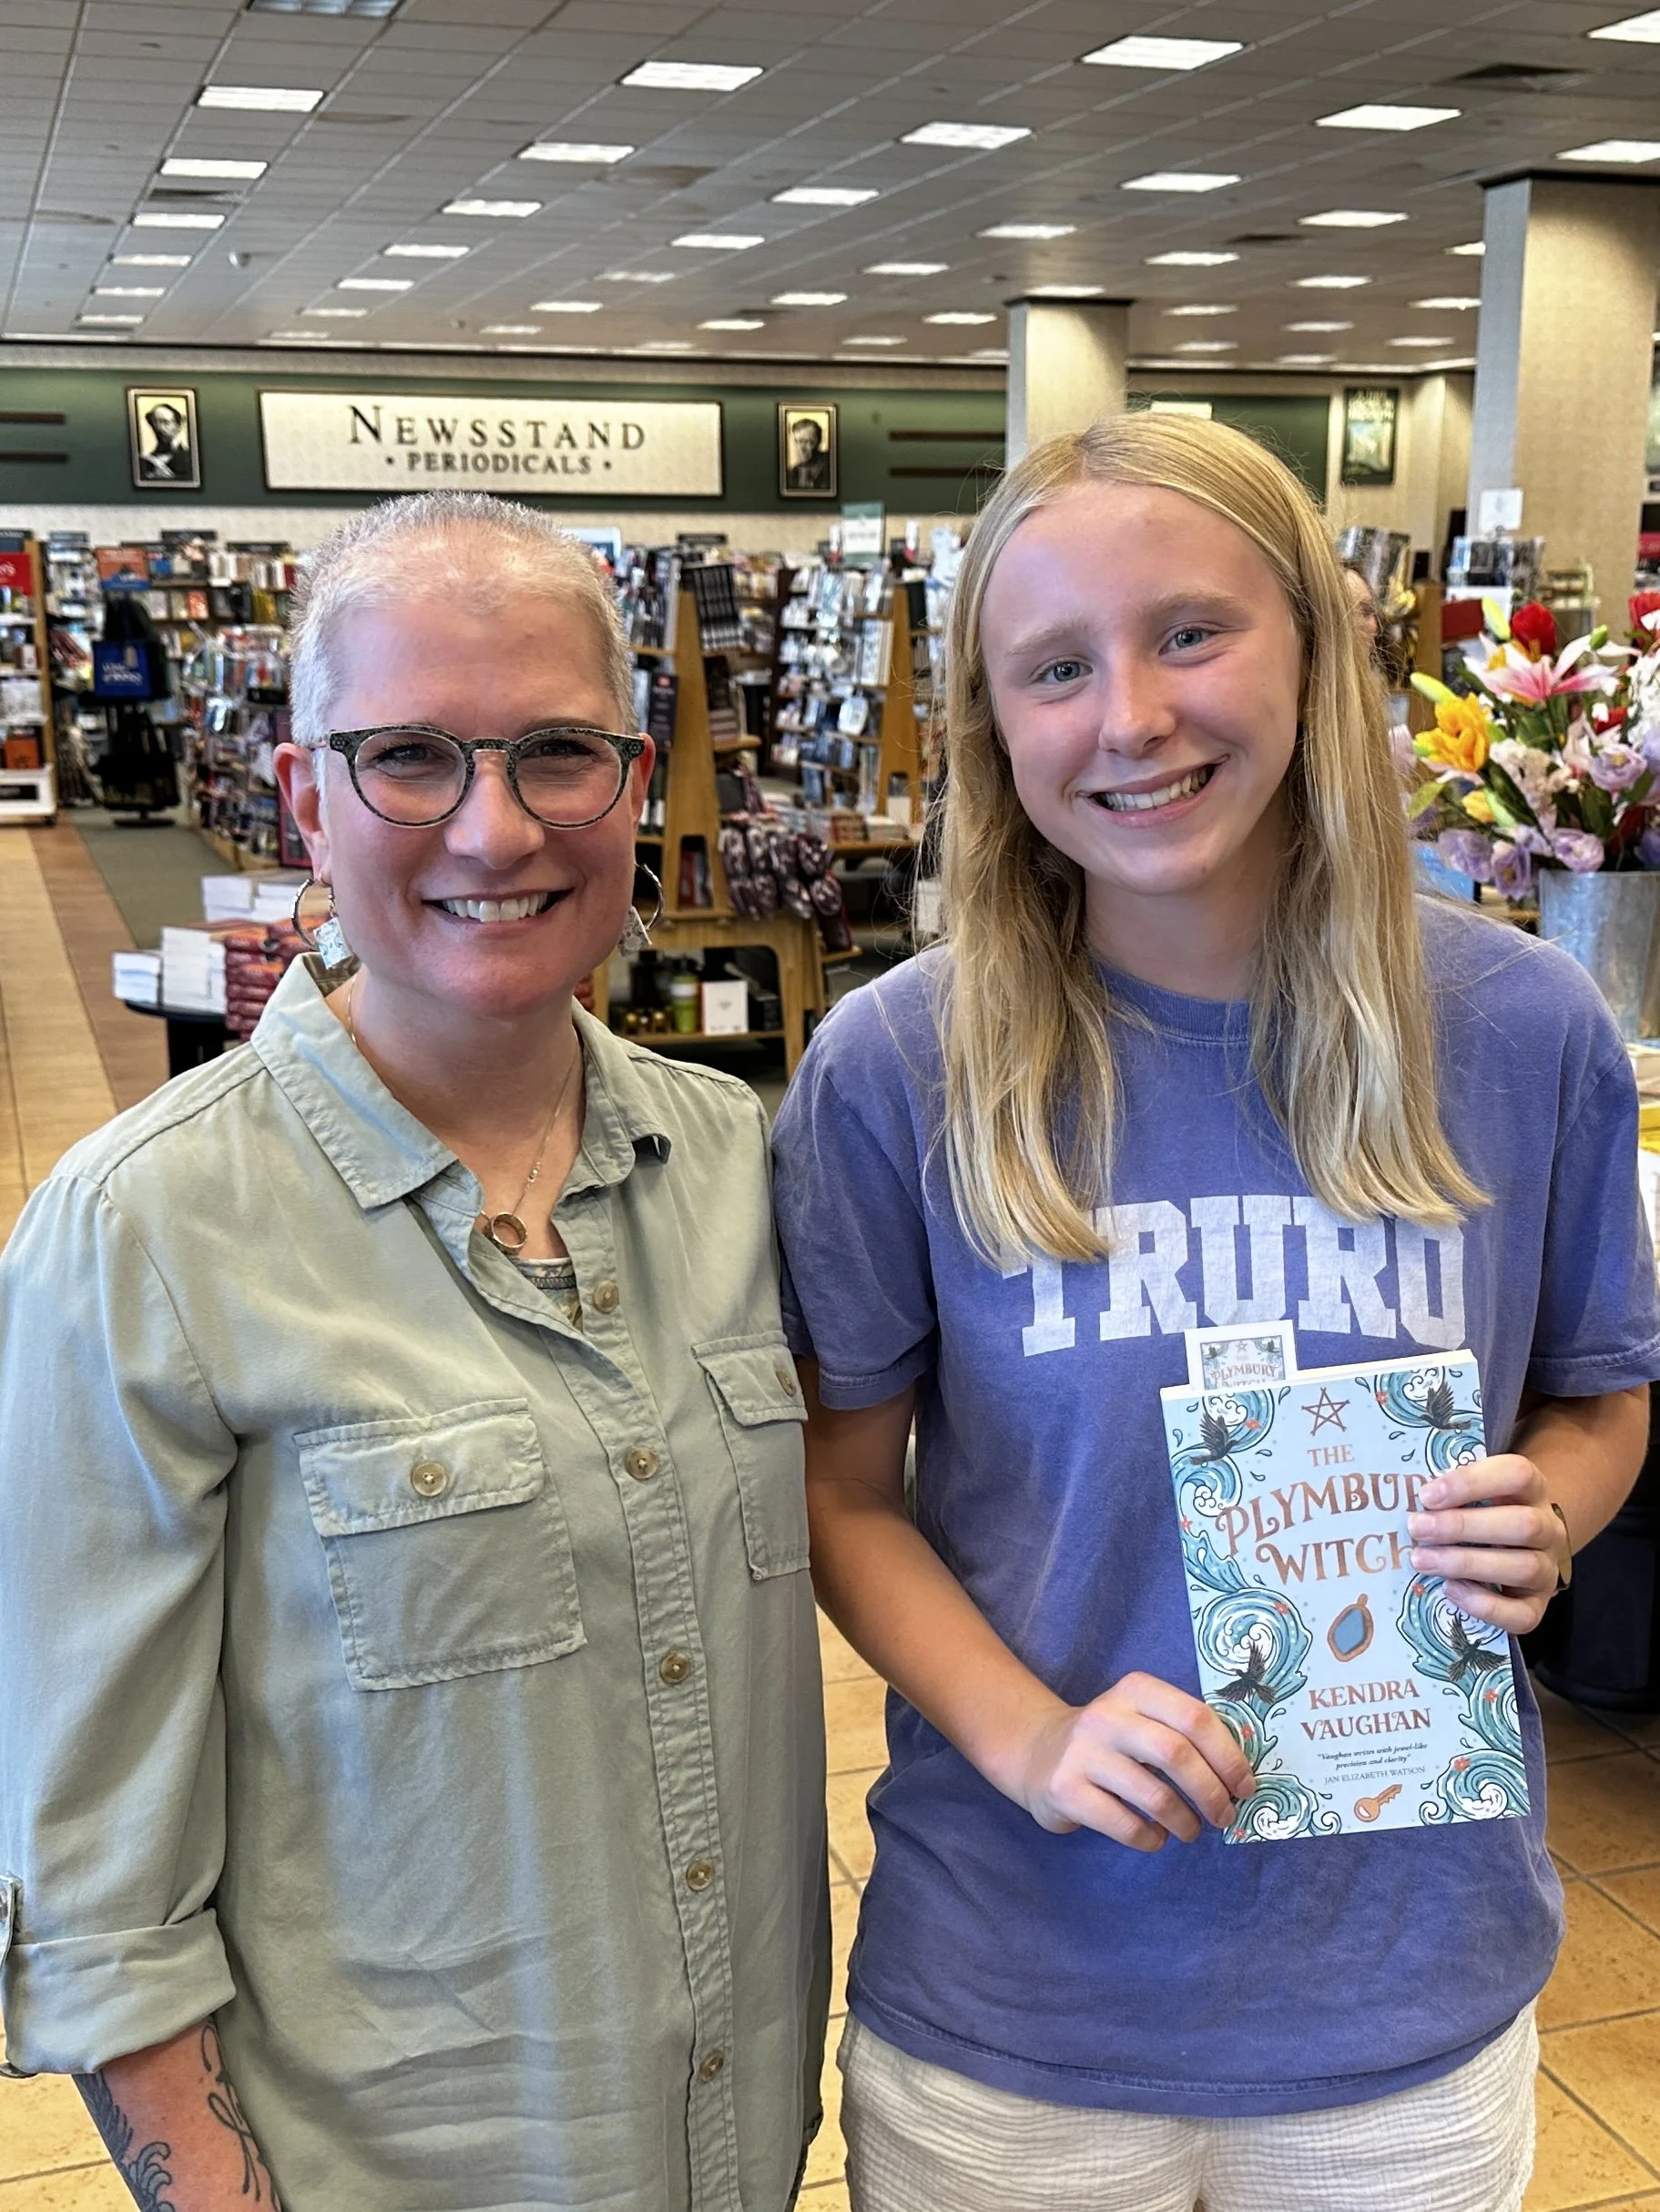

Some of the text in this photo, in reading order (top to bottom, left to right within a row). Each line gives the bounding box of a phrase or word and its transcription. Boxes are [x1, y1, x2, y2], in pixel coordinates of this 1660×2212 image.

[349, 405, 646, 450] NEWSSTAND
[407, 452, 592, 474] PERIODICALS
[1003, 1195, 1465, 1356] TRURO
[1210, 1363, 1276, 1381] PLYMBURY
[1307, 1443, 1355, 1467] THE
[1215, 1473, 1436, 1557] PLYMBUR
[1309, 1677, 1420, 1709] KENDRA
[1300, 1707, 1431, 1740] VAUGHAN
[1377, 1746, 1392, 1754] with
[1325, 1766, 1426, 1785] JAN ELIZABETH WATSON
[1336, 1760, 1367, 1770] precision
[1369, 1757, 1383, 1765] and
